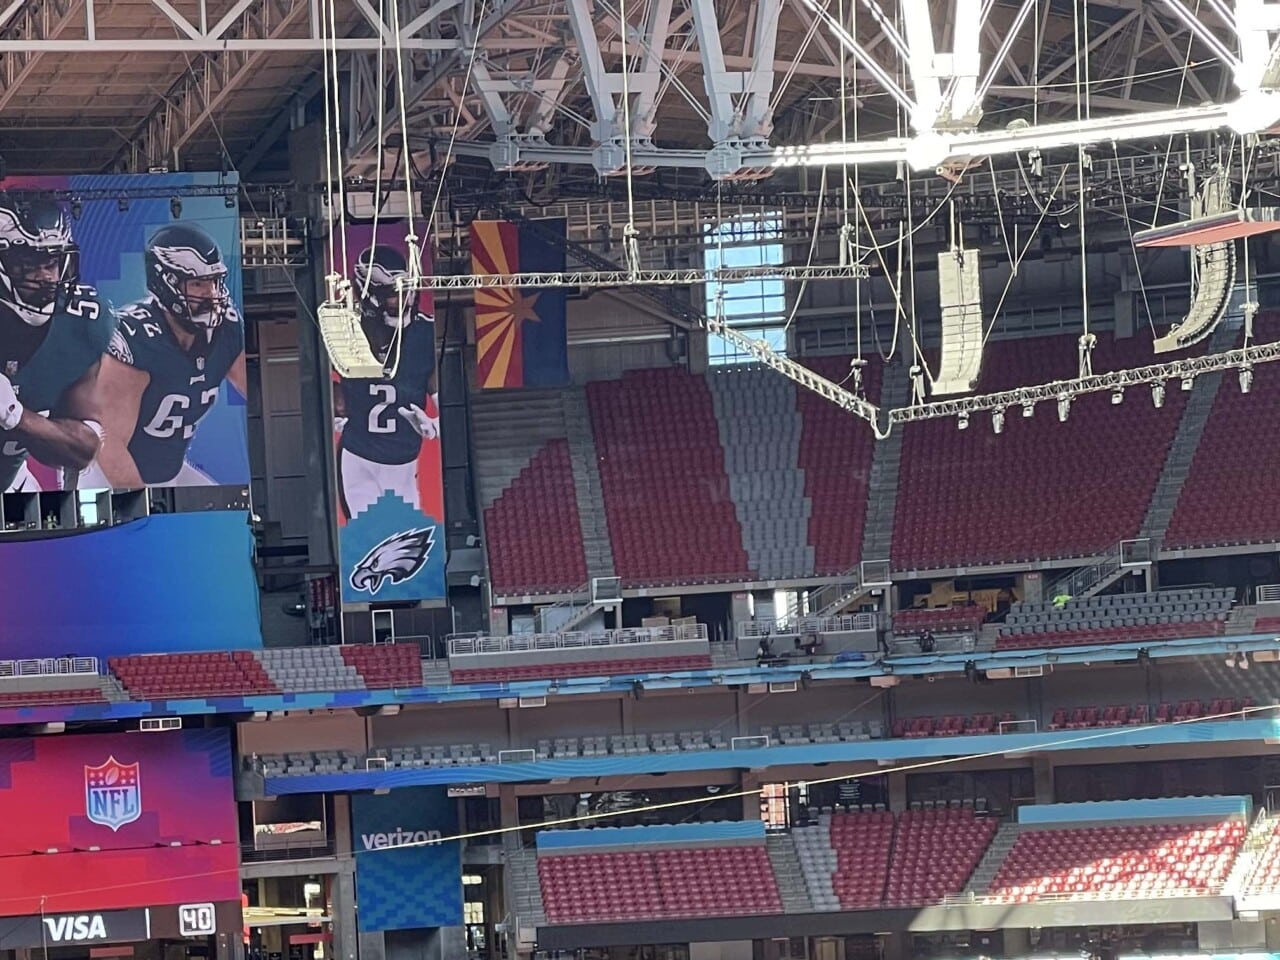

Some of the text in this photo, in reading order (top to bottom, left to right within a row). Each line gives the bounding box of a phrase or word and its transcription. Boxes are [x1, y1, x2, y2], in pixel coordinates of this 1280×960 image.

[368, 383, 397, 433] 2
[92, 788, 135, 819] NFL
[361, 827, 442, 850] verizon
[42, 915, 107, 942] VISA
[183, 907, 211, 931] 40
